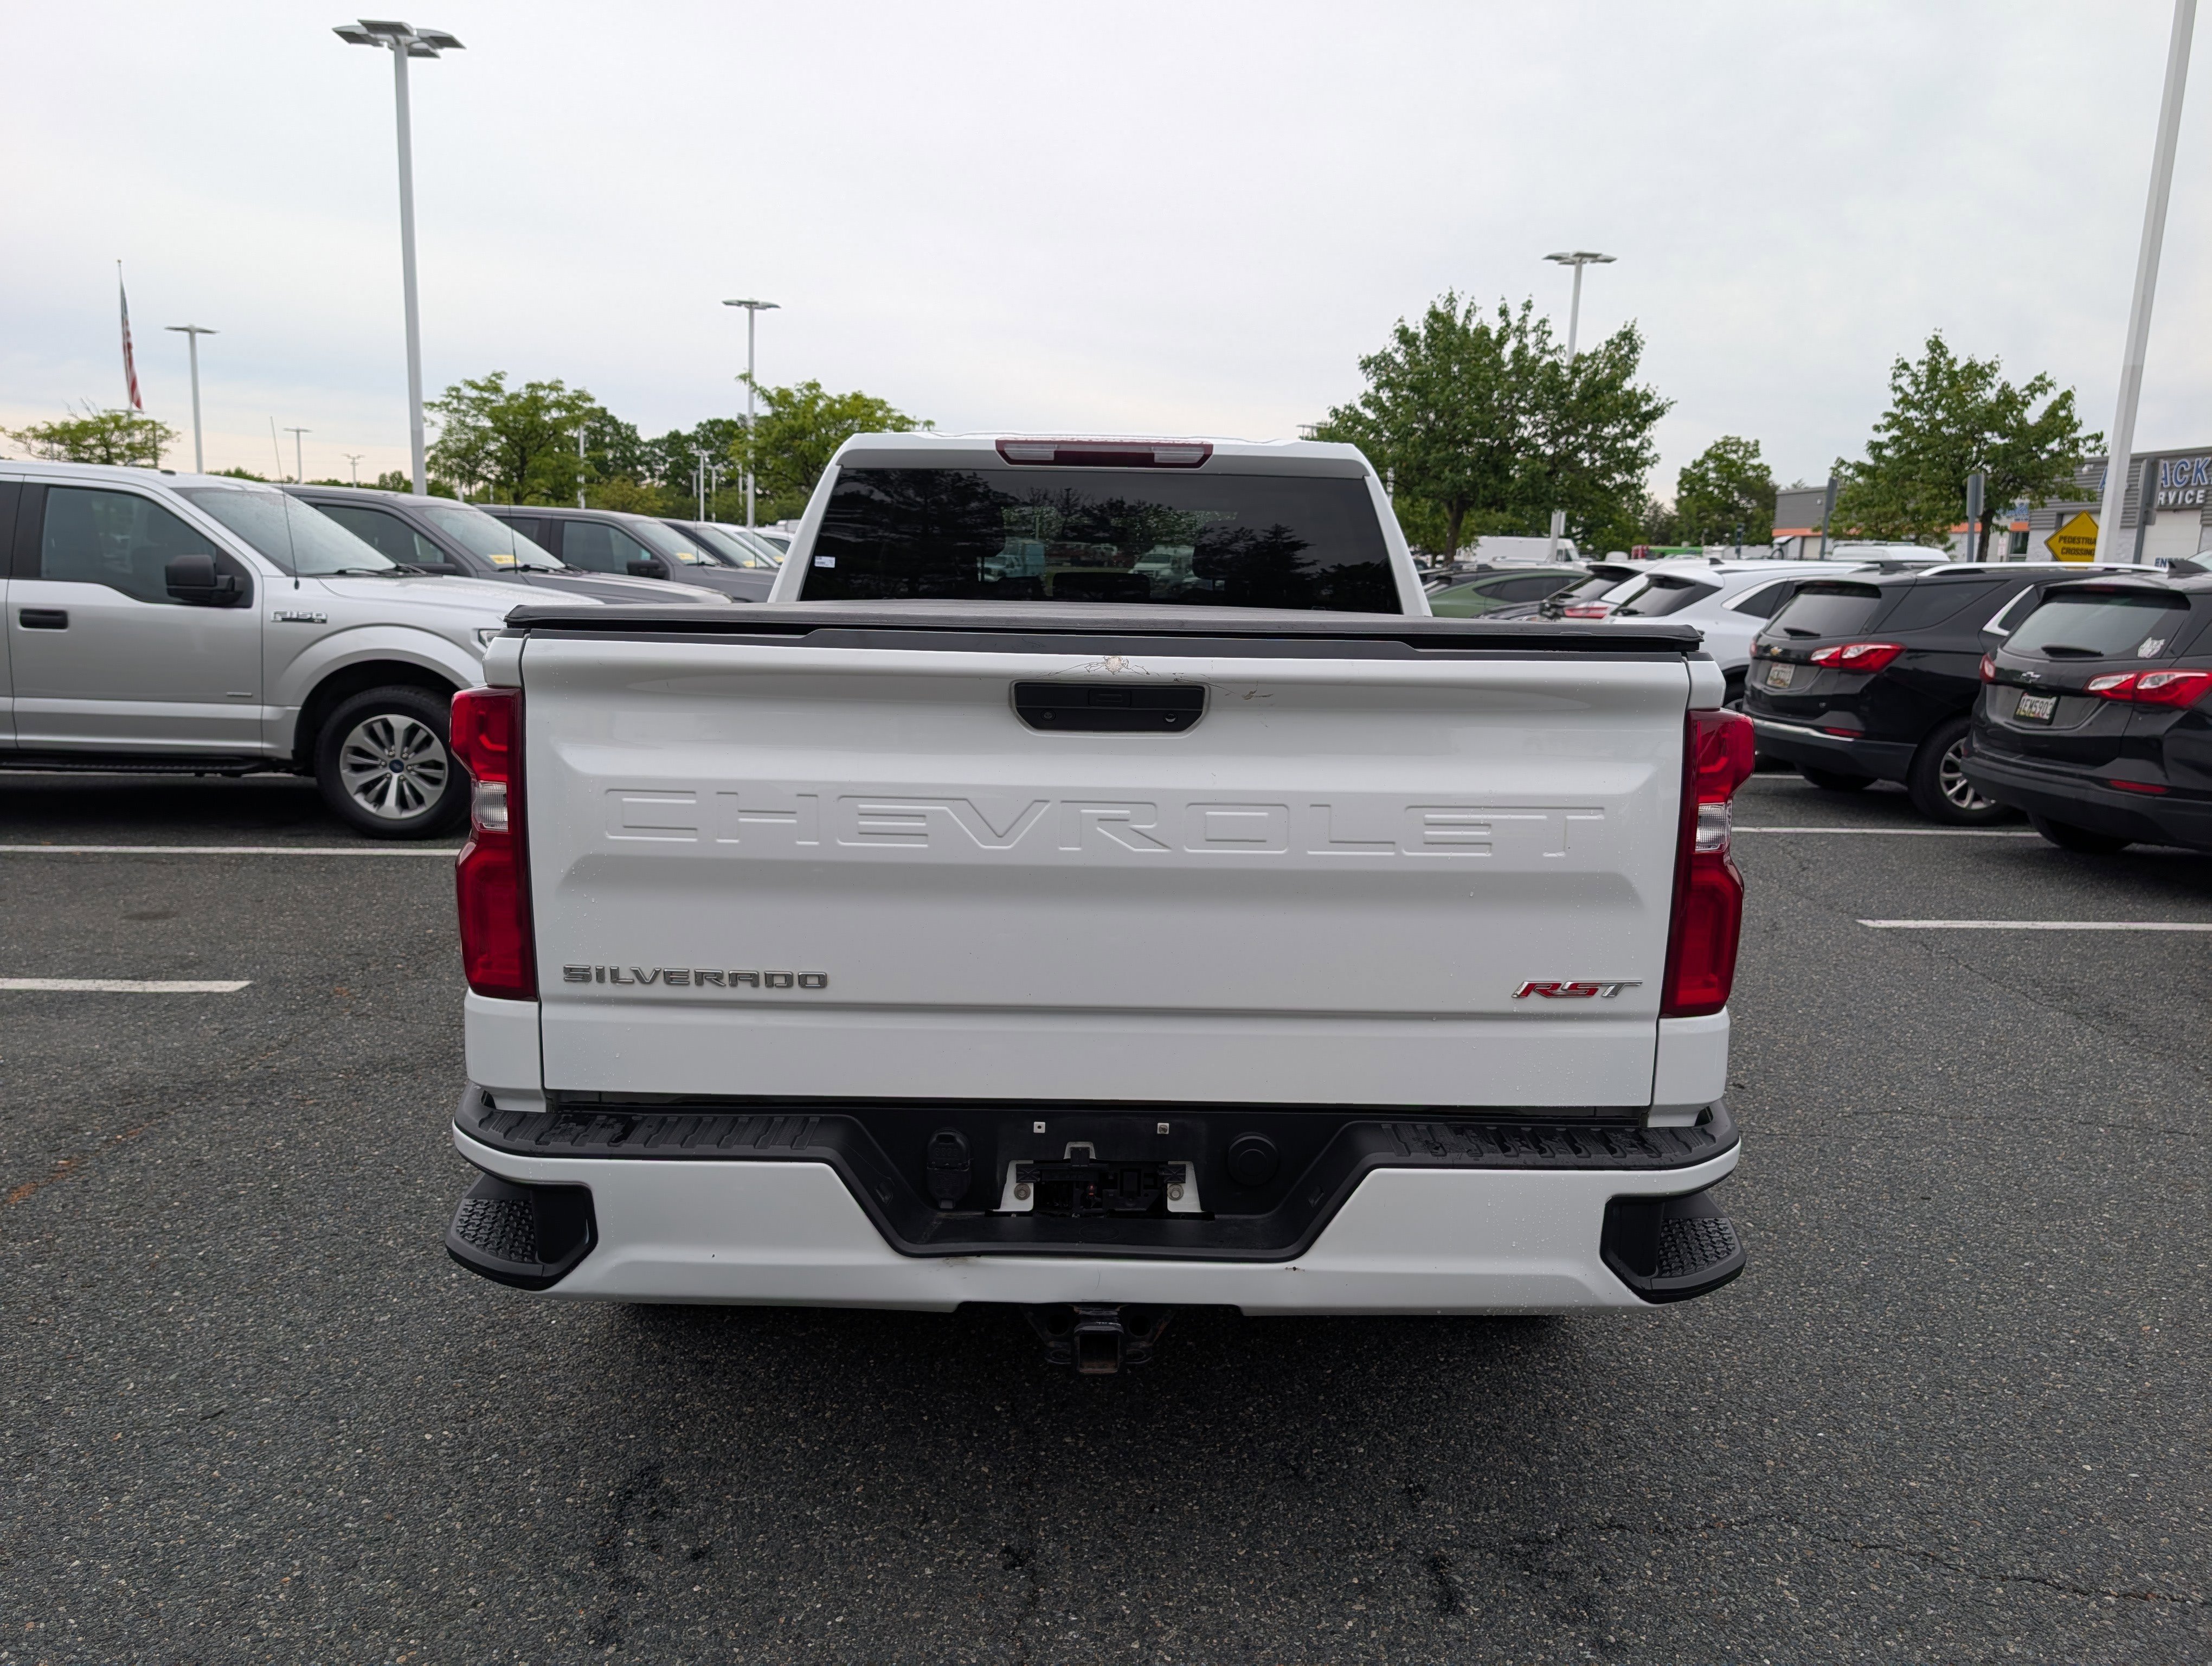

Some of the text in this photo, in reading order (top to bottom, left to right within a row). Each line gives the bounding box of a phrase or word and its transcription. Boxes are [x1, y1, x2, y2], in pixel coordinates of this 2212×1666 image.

[2157, 489, 2206, 505] RVICE
[605, 789, 1605, 856] CHEVROLET
[563, 964, 828, 989] SILVERADO
[1511, 979, 1643, 998] RST
